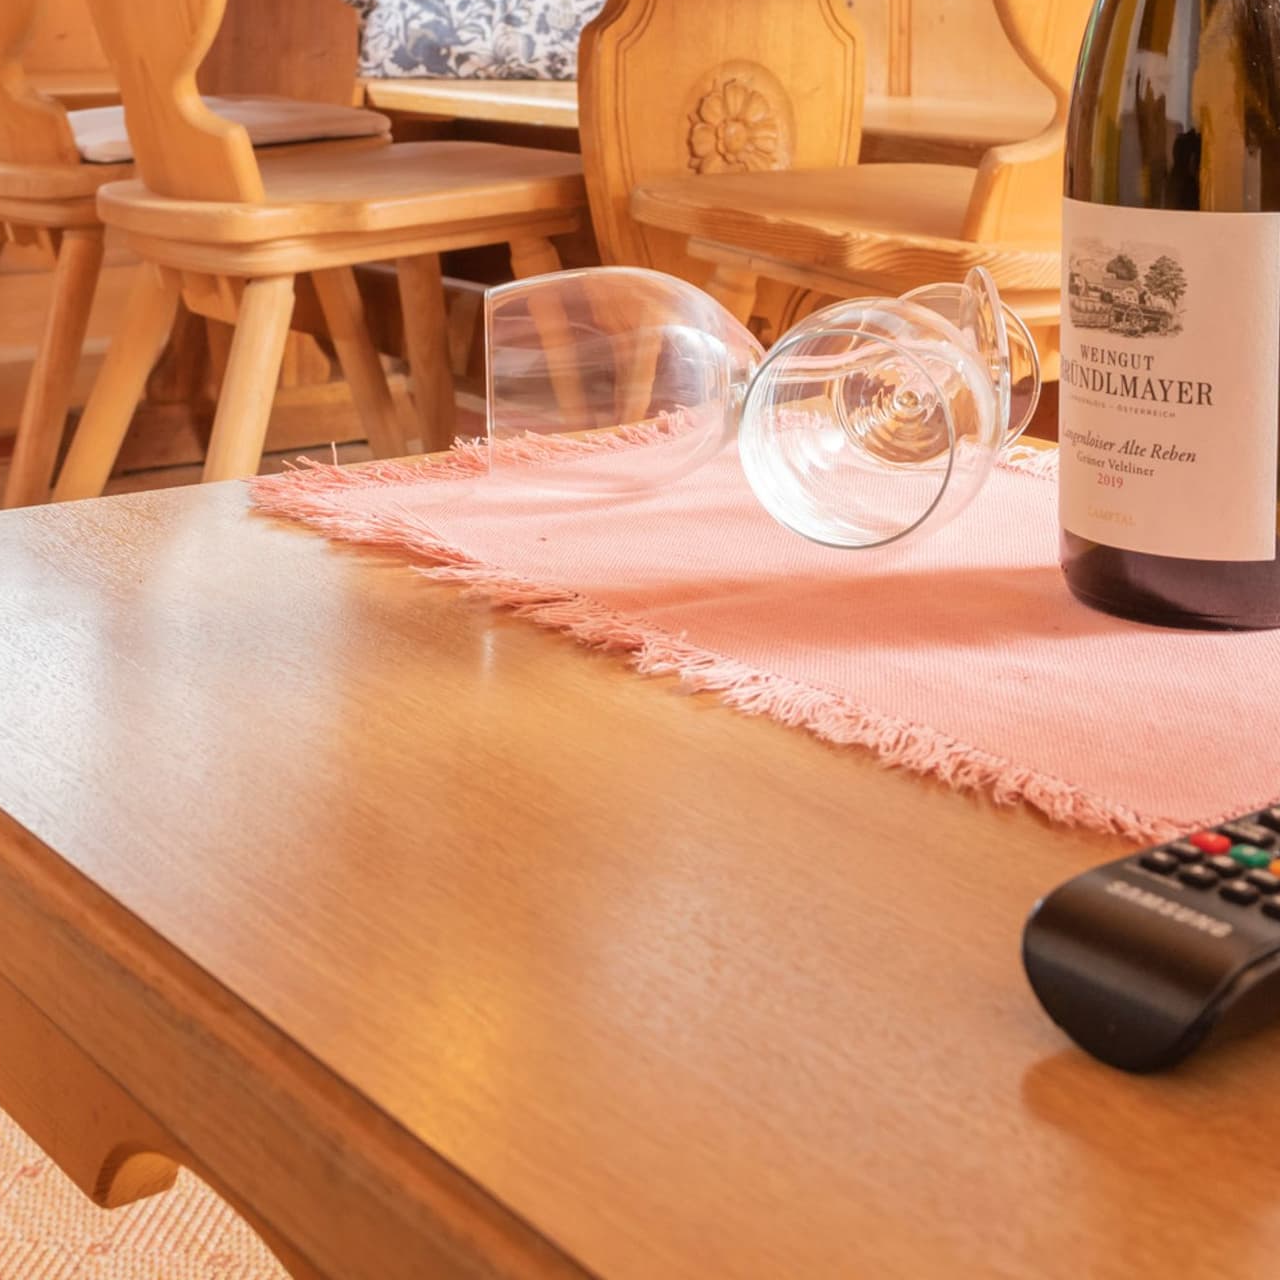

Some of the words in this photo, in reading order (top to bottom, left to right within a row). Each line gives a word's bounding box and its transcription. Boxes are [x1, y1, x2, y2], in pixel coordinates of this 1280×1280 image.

[1080, 344, 1154, 370] WEINGUT
[1117, 439, 1147, 458] Alte
[1150, 443, 1197, 463] Reben
[1108, 458, 1155, 477] Veltliner
[1097, 471, 1124, 488] 2019
